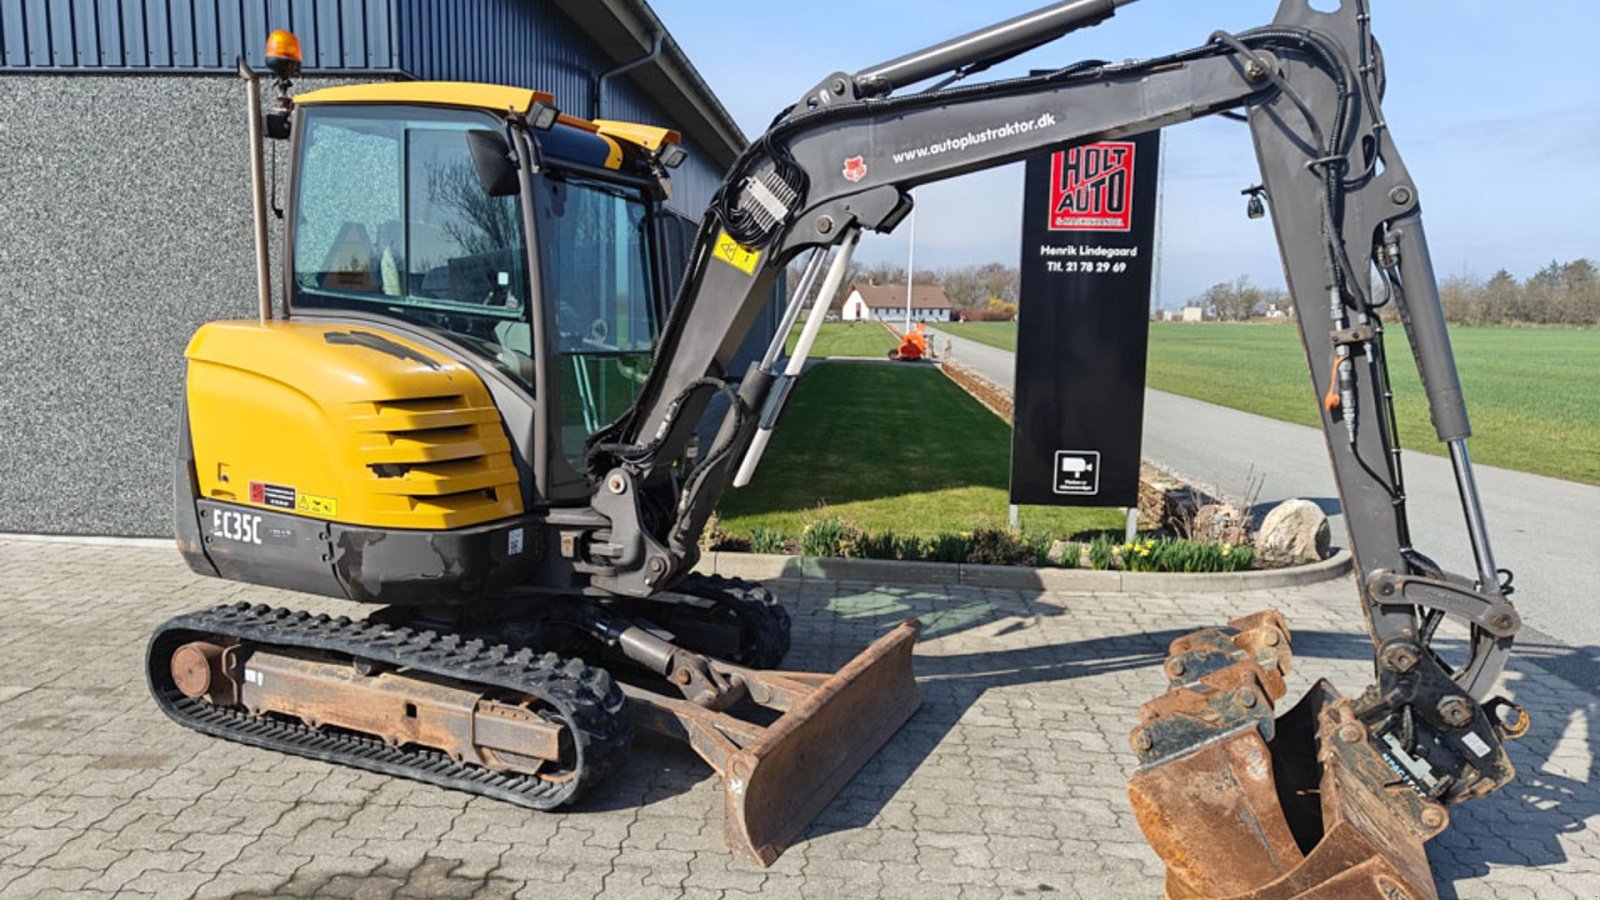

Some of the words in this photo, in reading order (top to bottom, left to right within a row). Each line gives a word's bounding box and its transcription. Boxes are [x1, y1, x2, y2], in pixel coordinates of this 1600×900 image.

[892, 113, 1056, 164] www.autoplustraktor.dk
[1060, 147, 1127, 192] HOLT
[1057, 168, 1126, 213] AUTO
[1040, 245, 1077, 256] Henrik
[1080, 245, 1138, 258] Lindegaard
[1047, 261, 1064, 272] Tlf.
[1066, 261, 1078, 272] 21
[1080, 261, 1094, 272] 78
[1096, 261, 1110, 273] 29
[1112, 262, 1127, 273] 69
[213, 509, 262, 544] EC35C
